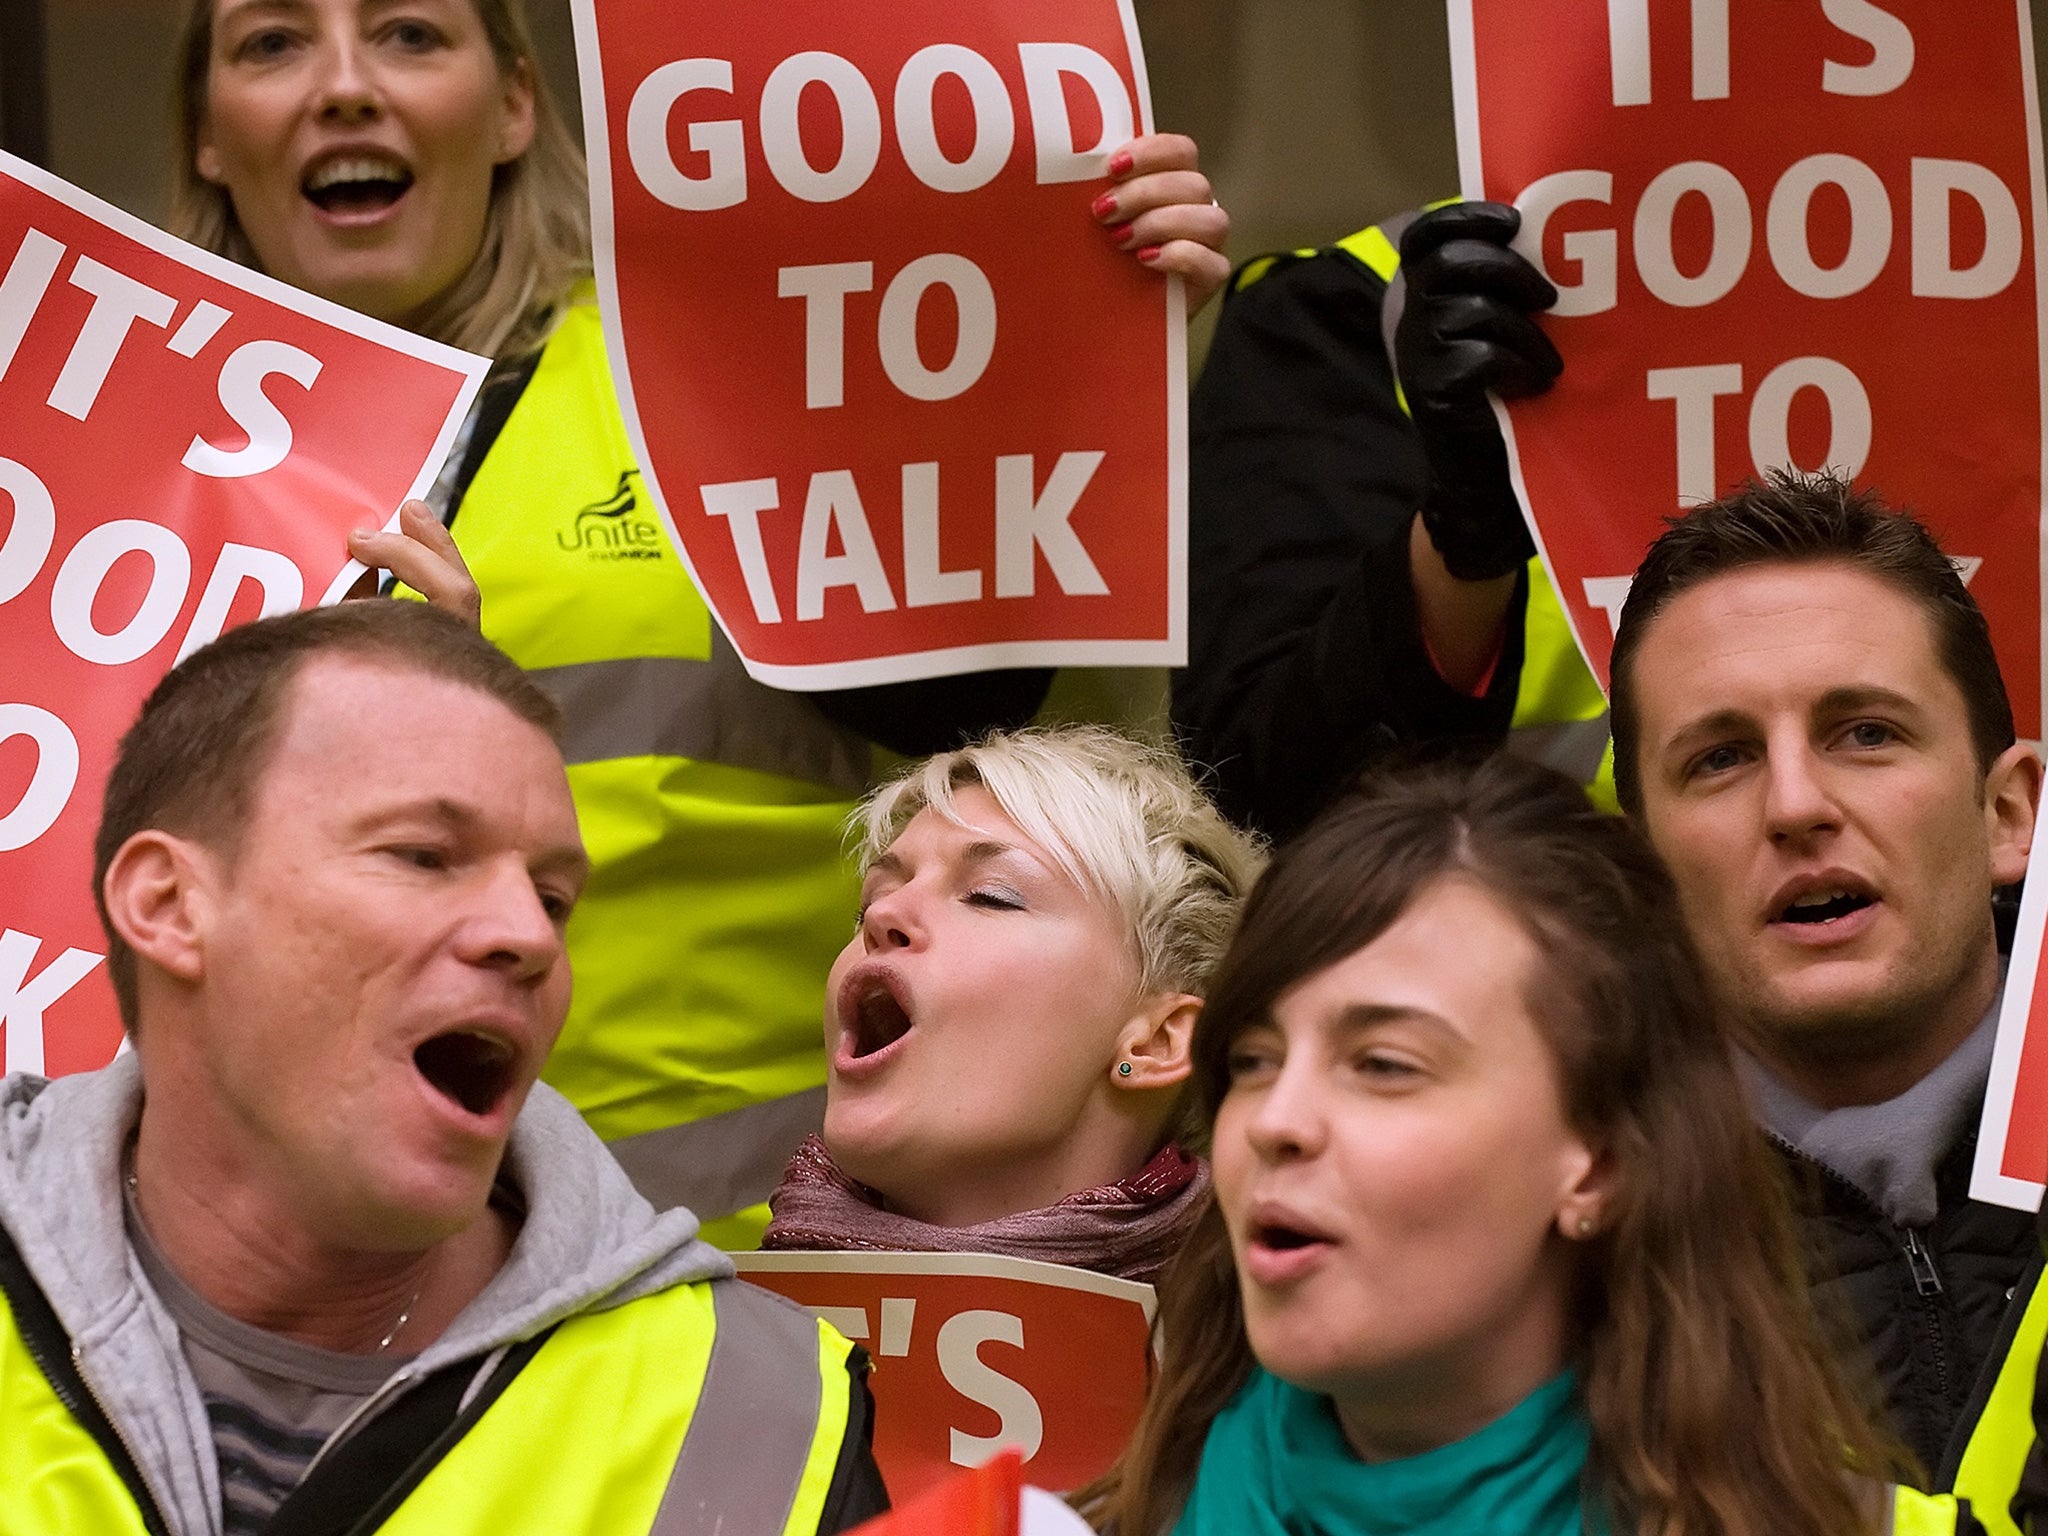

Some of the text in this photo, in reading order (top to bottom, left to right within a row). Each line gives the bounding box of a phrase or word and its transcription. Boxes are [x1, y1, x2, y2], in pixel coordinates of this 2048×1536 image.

[627, 43, 1134, 211] GOOD
[1608, 0, 1915, 106] ITS
[1512, 153, 2023, 317] GOOD
[0, 226, 324, 478] IT'S
[778, 253, 997, 410] TO
[1647, 356, 1872, 509] TO
[700, 450, 1111, 624] TALK
